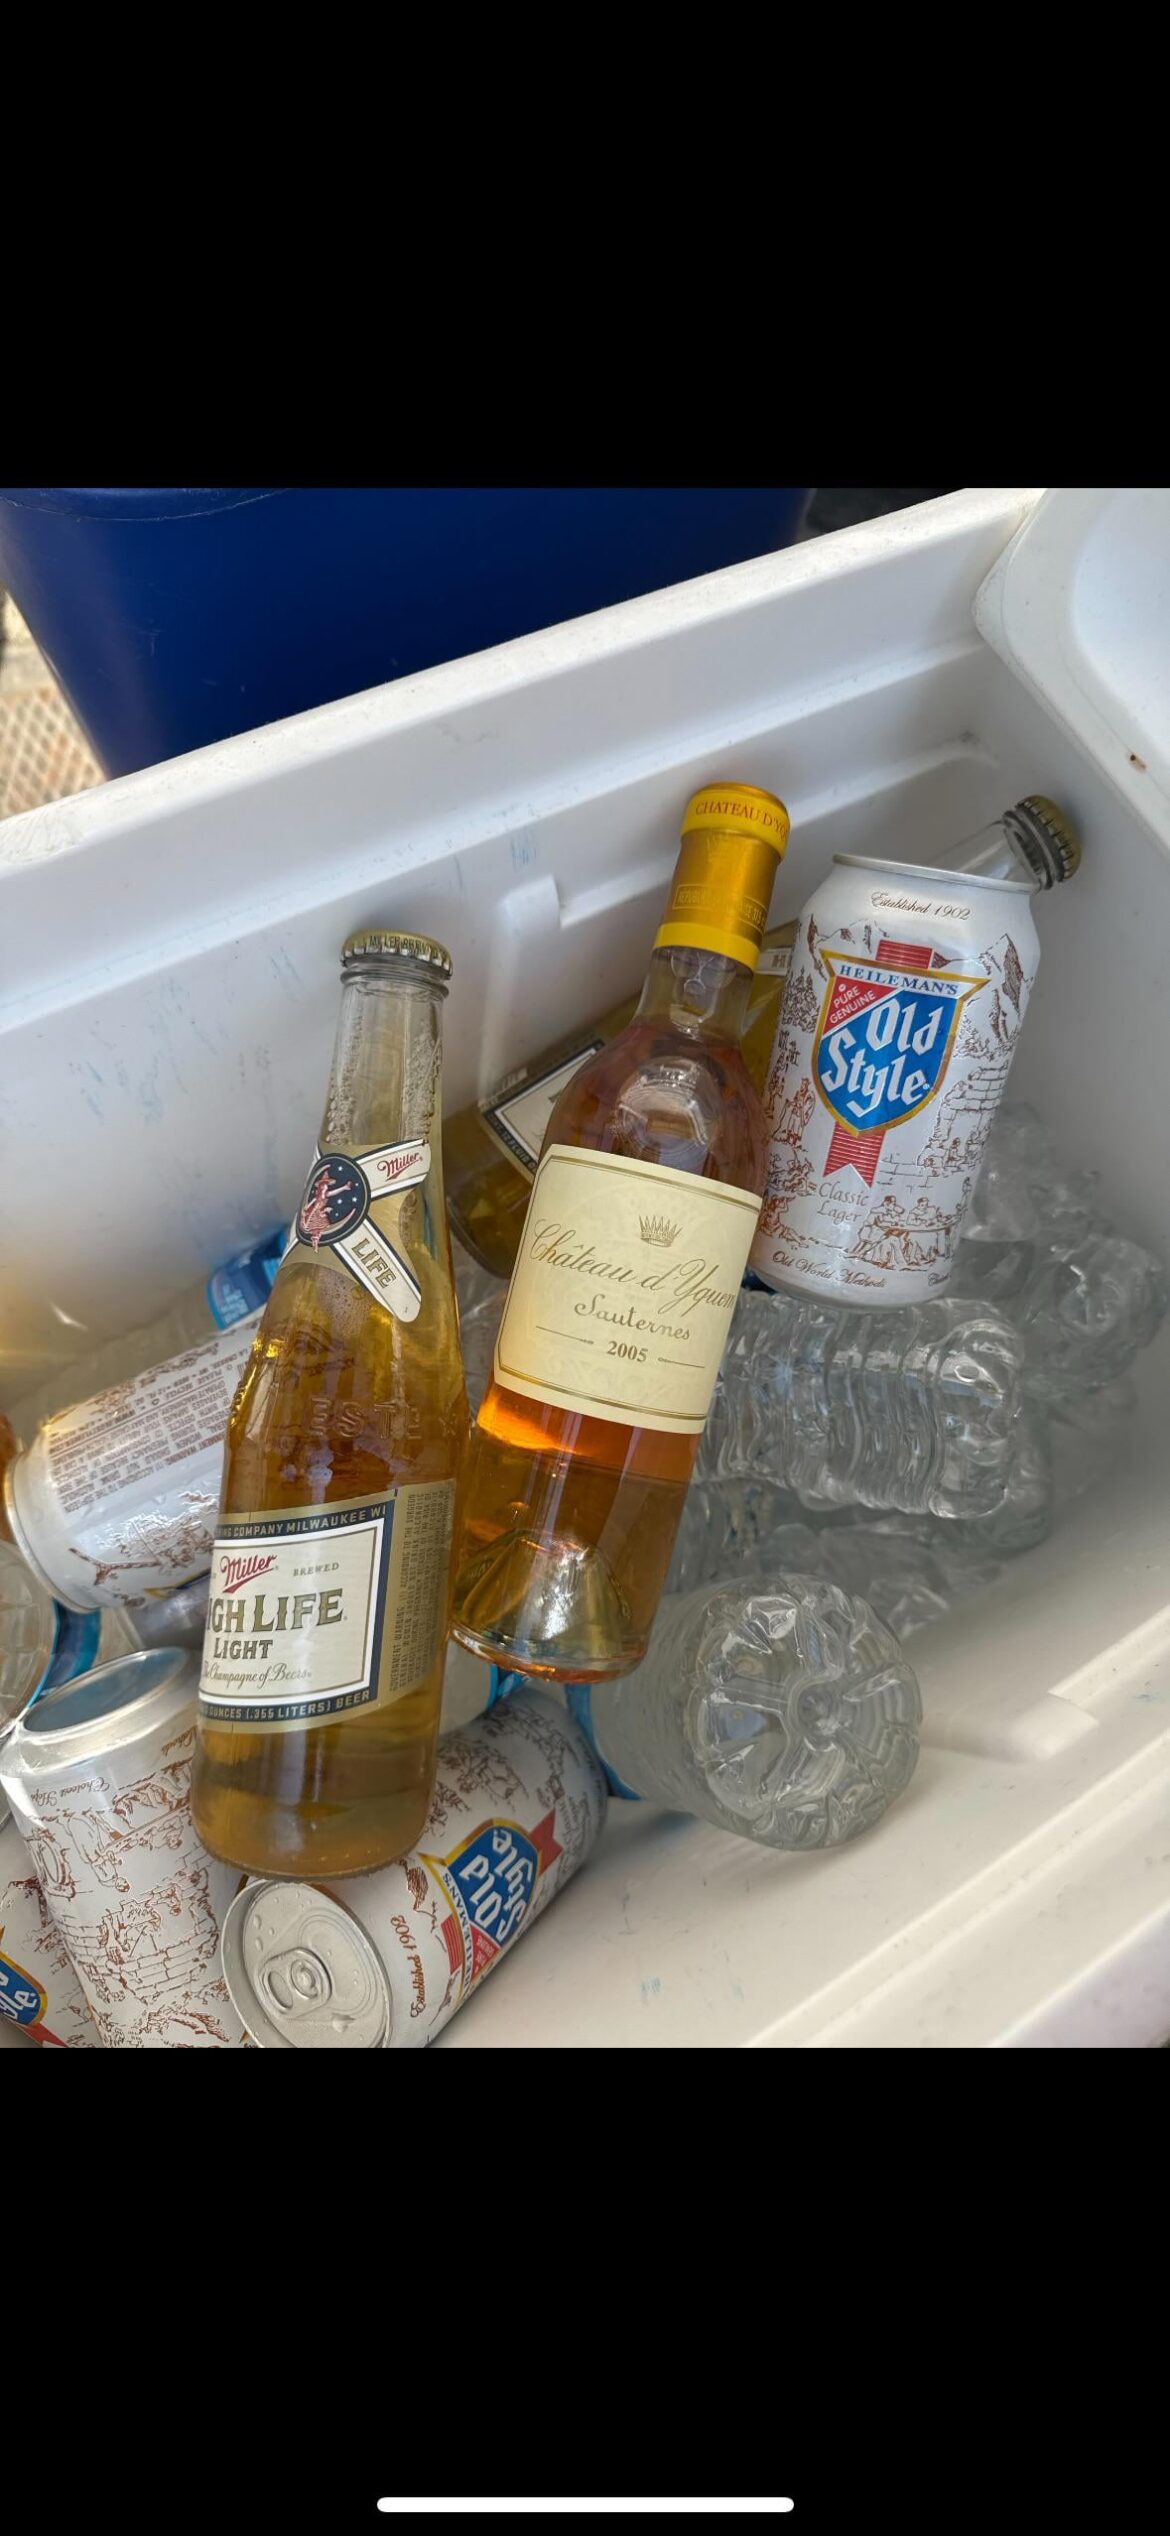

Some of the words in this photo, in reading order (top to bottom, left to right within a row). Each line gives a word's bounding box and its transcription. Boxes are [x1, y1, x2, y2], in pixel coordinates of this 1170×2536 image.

[695, 801, 759, 821] CHATEAU
[871, 891, 929, 914] Established
[934, 904, 971, 921] 1902
[840, 965, 958, 995] HEILEMAN'S
[829, 990, 876, 1024] GENUINE
[834, 986, 861, 1009] PURE
[866, 998, 944, 1056] Old
[820, 1028, 926, 1118] Style
[377, 1152, 419, 1181] Miller
[818, 1181, 870, 1207] Classic
[817, 1201, 863, 1226] Lager
[351, 1238, 396, 1288] LIFE
[530, 1219, 637, 1283] Château
[772, 1250, 793, 1267] Old
[795, 1258, 834, 1280] World
[838, 1268, 886, 1288] Methods
[574, 1294, 691, 1341] Sauternes
[606, 1340, 648, 1363] 2005
[234, 1523, 282, 1538] COMPANY
[287, 1507, 367, 1533] MILWAUKEE
[371, 1505, 387, 1519] WI
[220, 1554, 278, 1594] Miller
[293, 1561, 341, 1578] BREWED
[252, 1587, 344, 1633] LIFE
[213, 1637, 274, 1660] LIGHT
[208, 1661, 260, 1690] Champagne
[257, 1666, 273, 1690] of
[269, 1662, 307, 1683] Beers
[209, 1706, 242, 1719] OUNCES
[278, 1701, 331, 1718] LITERS)
[336, 1690, 371, 1709] BEER
[30, 1787, 58, 1807] Hops
[59, 1776, 110, 1798] Choicest
[458, 1854, 503, 1930] Old
[491, 1828, 535, 1942] Style
[391, 1914, 417, 1951] 1902
[407, 1953, 427, 2018] Established
